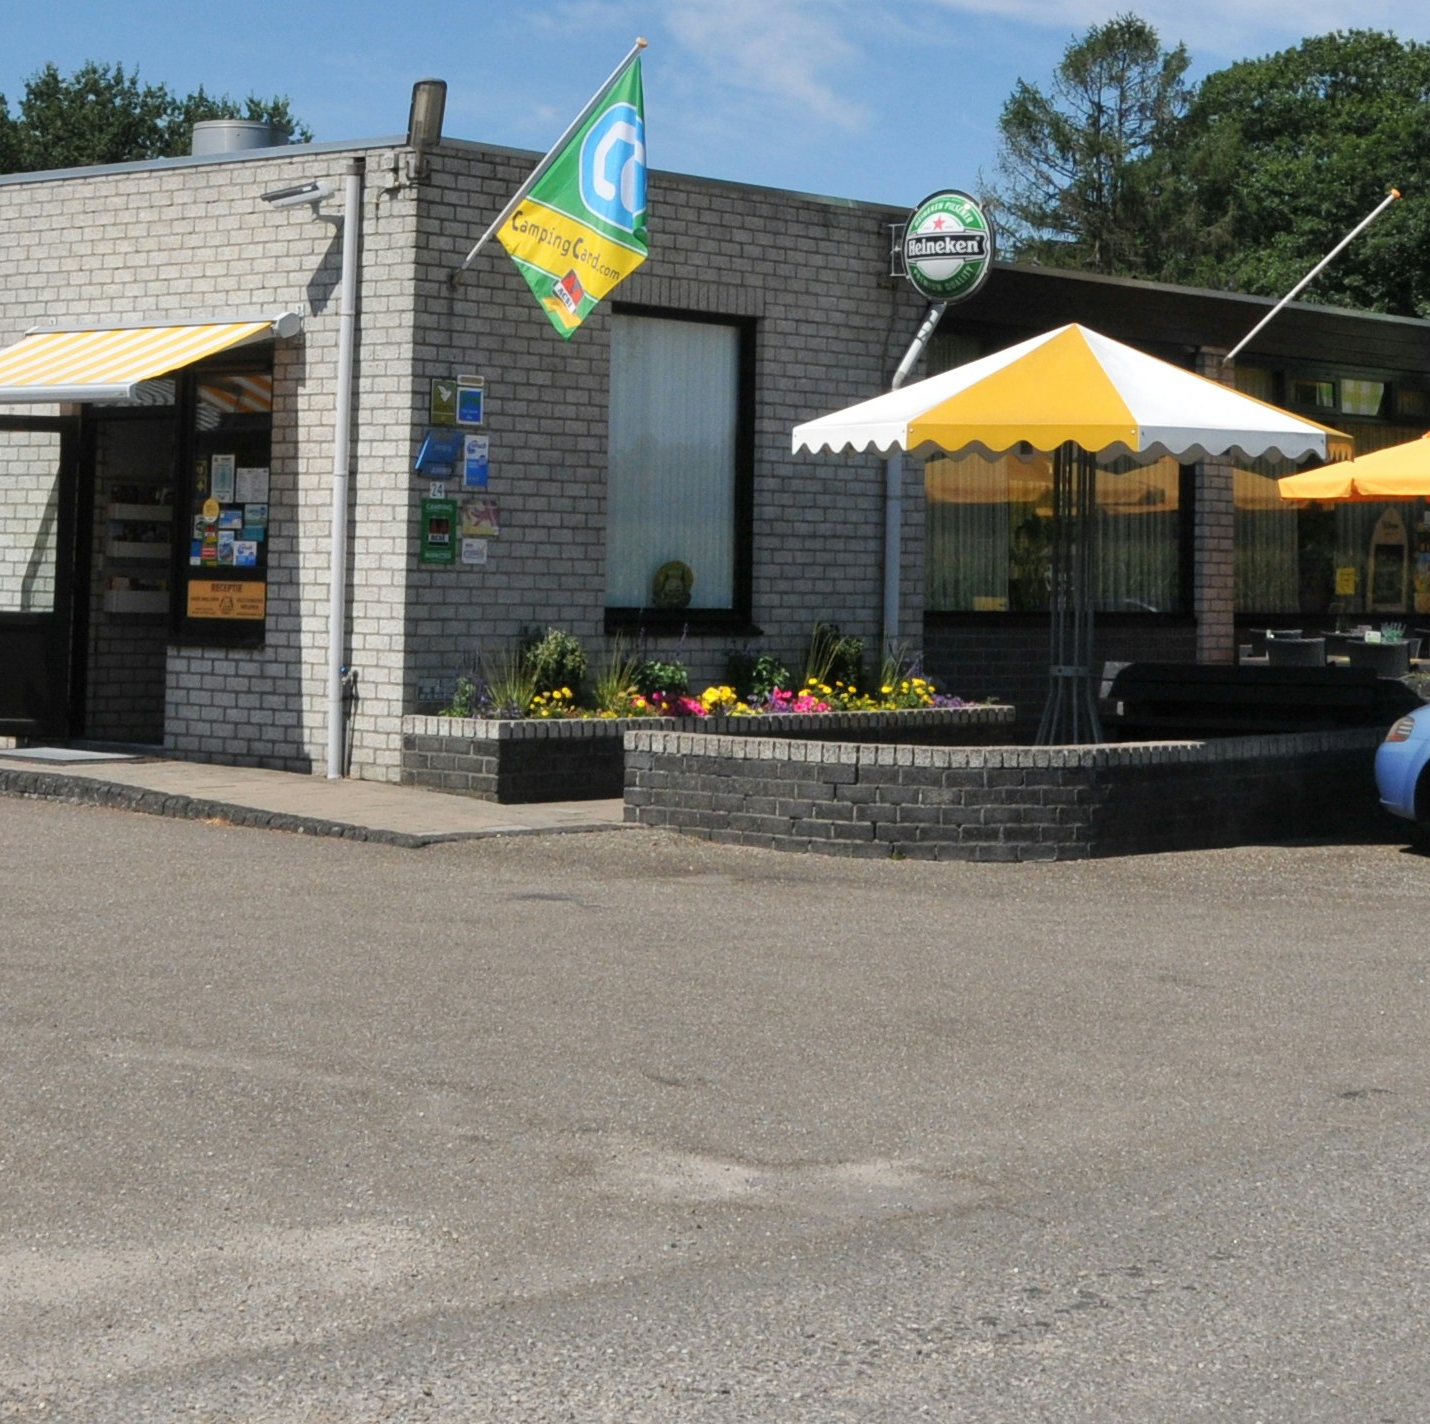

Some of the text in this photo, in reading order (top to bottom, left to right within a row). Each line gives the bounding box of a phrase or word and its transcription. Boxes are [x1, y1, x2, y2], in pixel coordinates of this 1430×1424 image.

[511, 209, 621, 282] CampingCard.com
[908, 237, 979, 257] Heineken
[945, 265, 973, 290] QUALITY
[431, 481, 444, 497] 24
